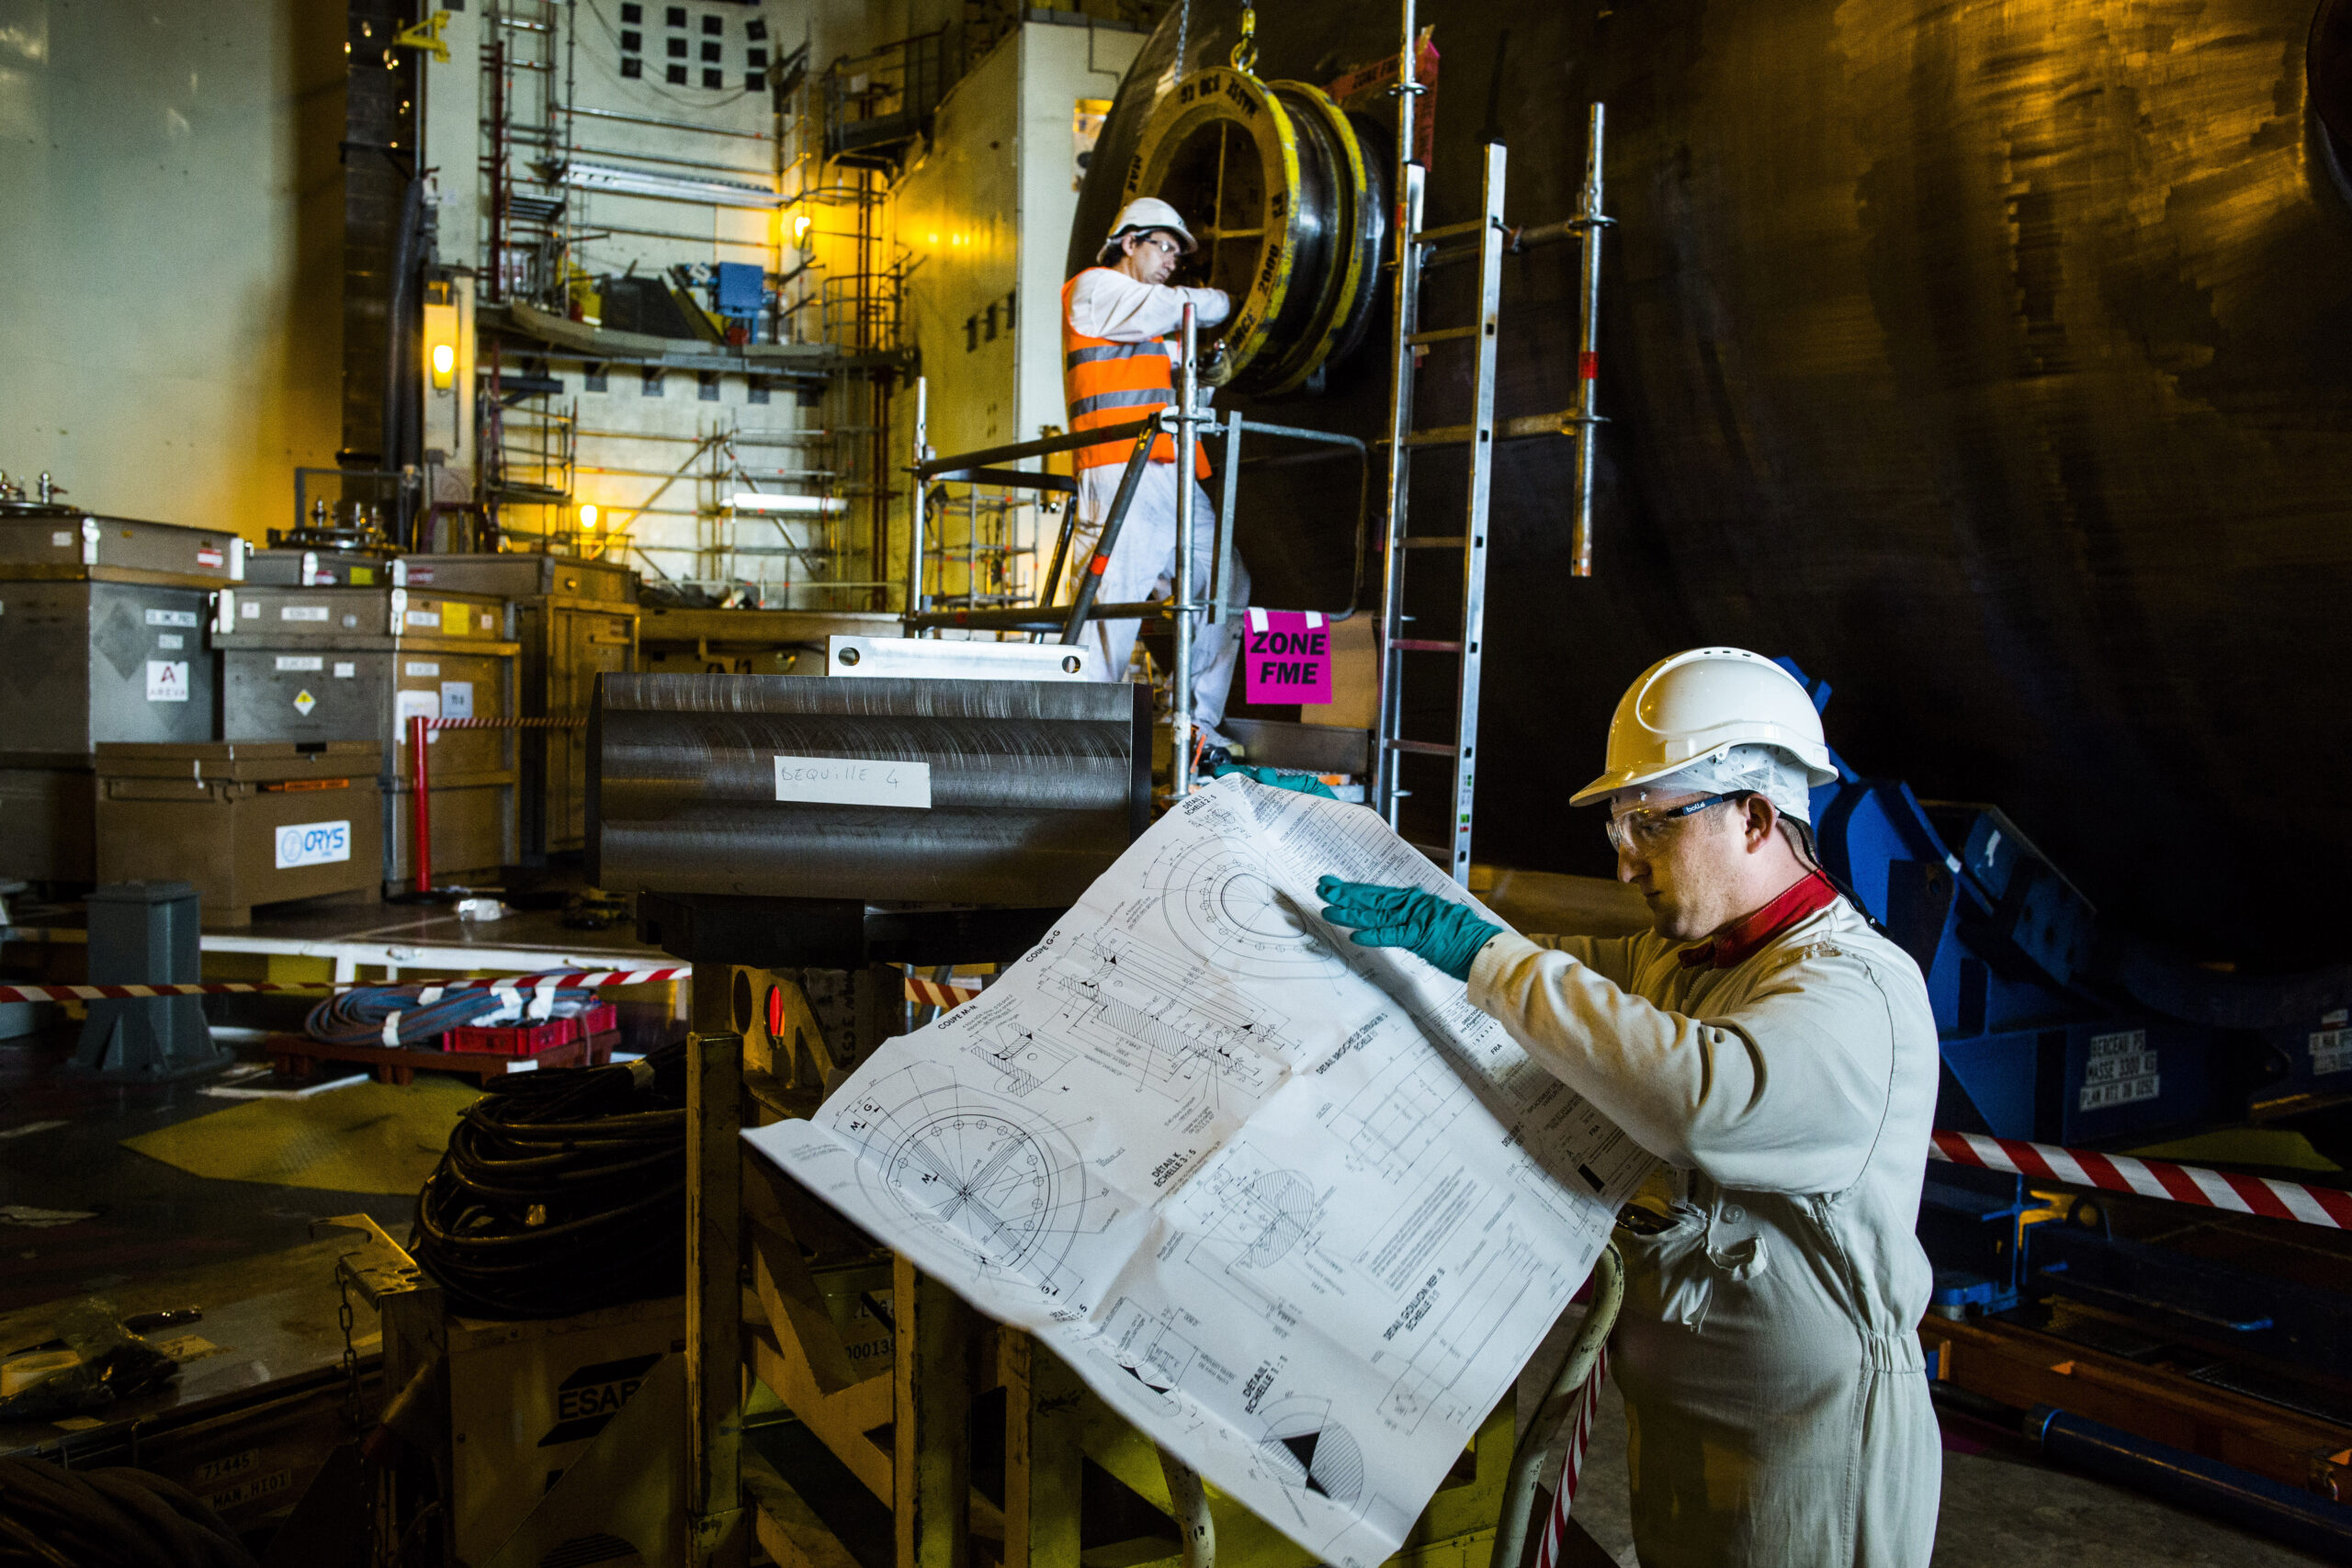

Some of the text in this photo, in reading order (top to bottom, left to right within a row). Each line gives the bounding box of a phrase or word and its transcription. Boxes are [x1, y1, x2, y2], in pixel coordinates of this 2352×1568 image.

[1231, 307, 1257, 351] ORCE
[1258, 243, 1279, 296] 2000
[1250, 632, 1326, 655] ZONE
[1260, 662, 1318, 684] FME
[149, 689, 186, 697] AREVA
[886, 769, 899, 789] 4
[1686, 802, 1705, 813] bollé
[304, 828, 345, 852] ORYS
[1024, 929, 1062, 964] COUPE G-G
[937, 1011, 962, 1031] COUPE
[960, 1002, 978, 1017] M-M
[1490, 1043, 1502, 1055] FRA
[2087, 1059, 2114, 1083] MASSE
[862, 1101, 873, 1112] G
[849, 1119, 861, 1131] M
[1588, 1123, 1600, 1136] FRA
[1149, 1150, 1181, 1179] DÉTAIL K
[1153, 1159, 1182, 1189] ECHELLE
[920, 1171, 933, 1184] M
[1040, 1284, 1051, 1295] G
[845, 1340, 893, 1359] 0013
[1239, 1362, 1268, 1398] DÉTAIL
[1243, 1372, 1274, 1415] ECHELLE
[204, 1454, 251, 1480] 71445
